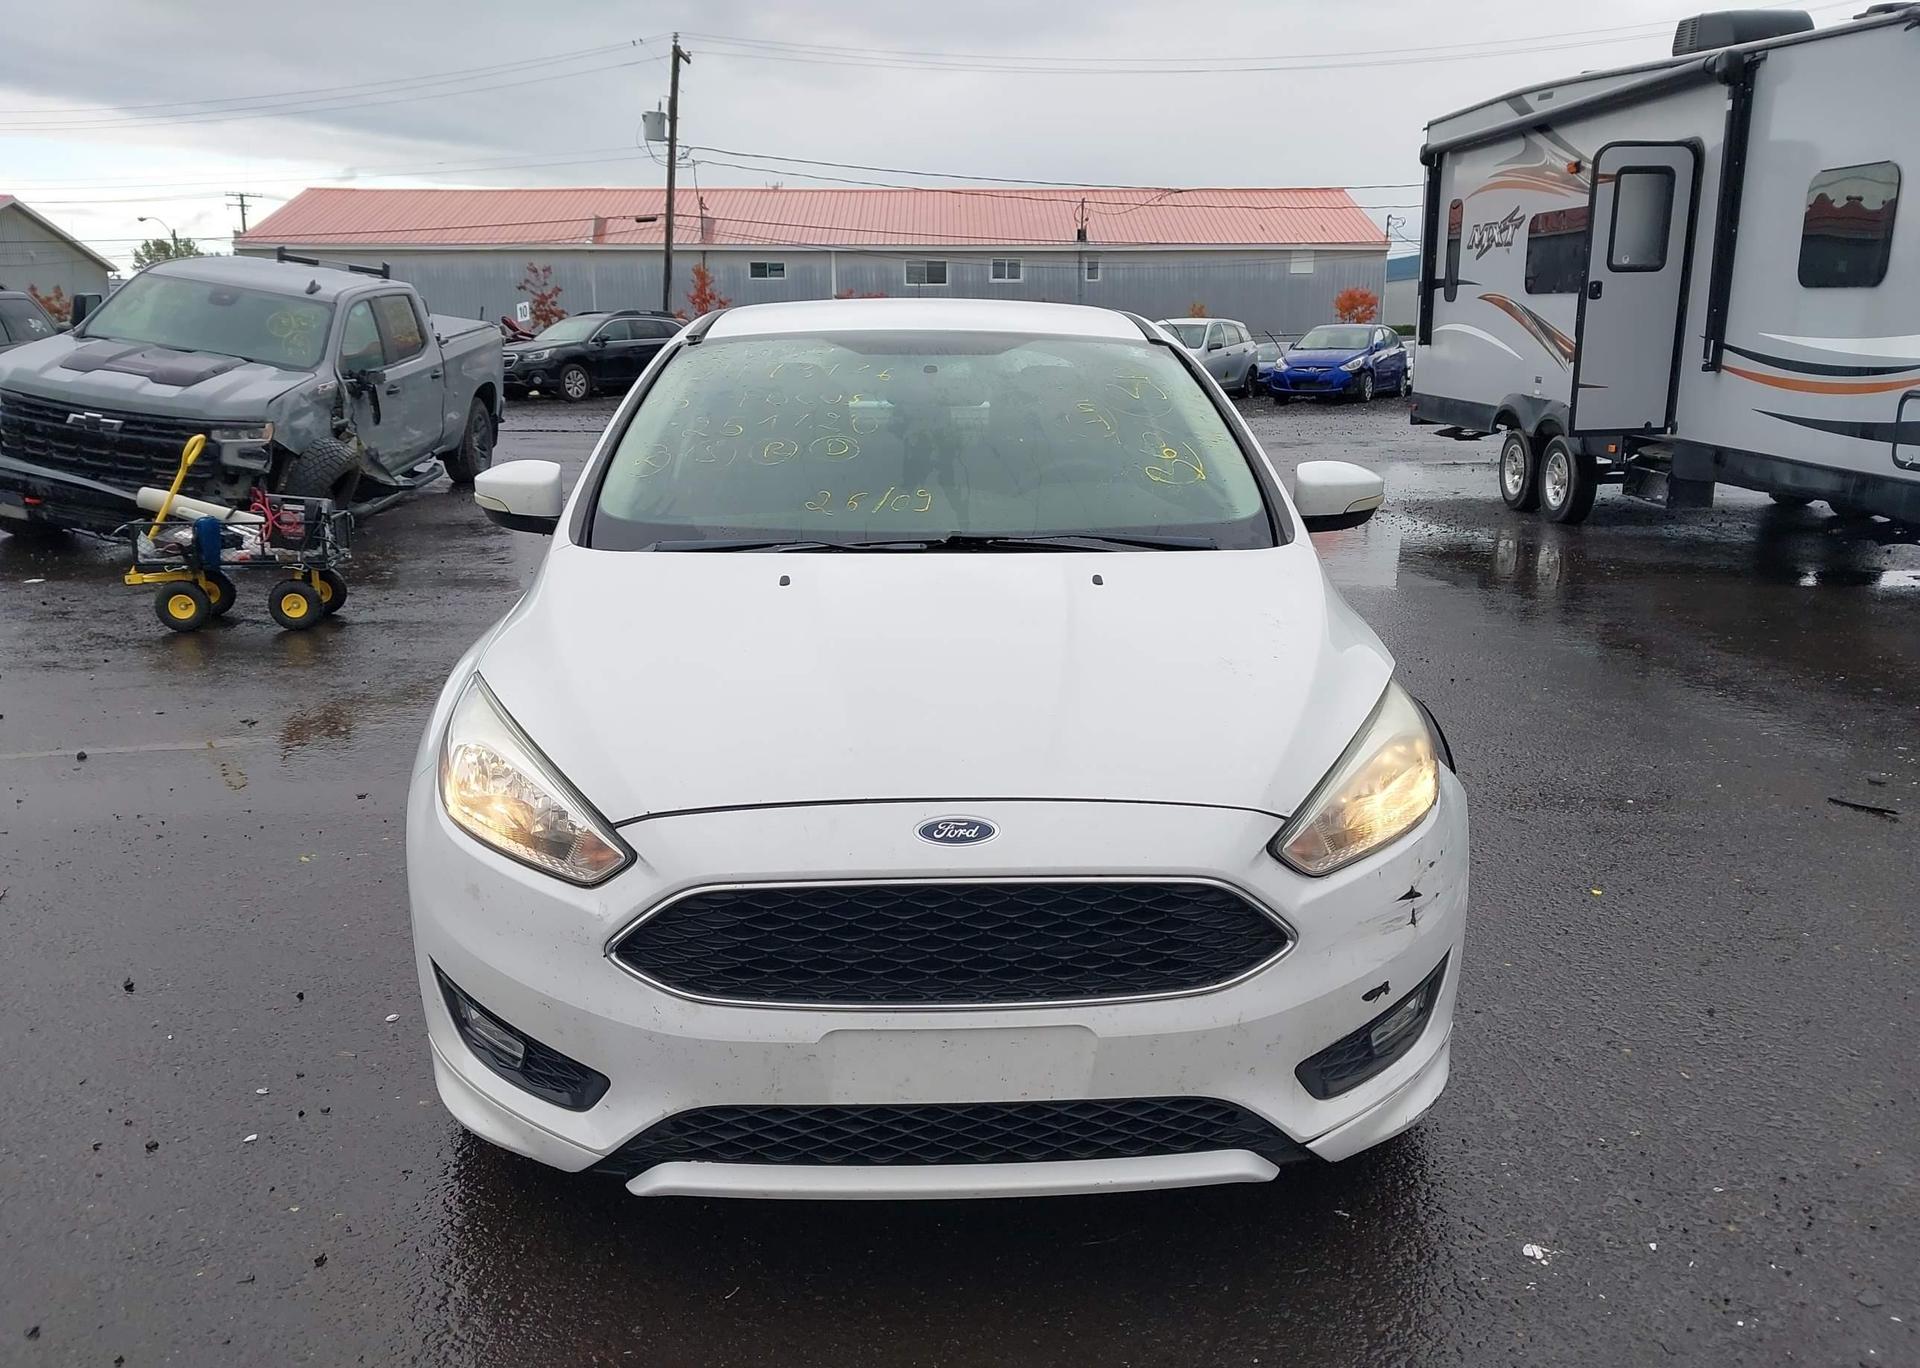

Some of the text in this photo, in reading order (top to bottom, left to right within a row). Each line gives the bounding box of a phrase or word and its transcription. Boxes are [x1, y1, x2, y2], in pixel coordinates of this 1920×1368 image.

[519, 304, 528, 319] 10
[804, 485, 933, 516] 26/09
[933, 821, 980, 839] Ford
